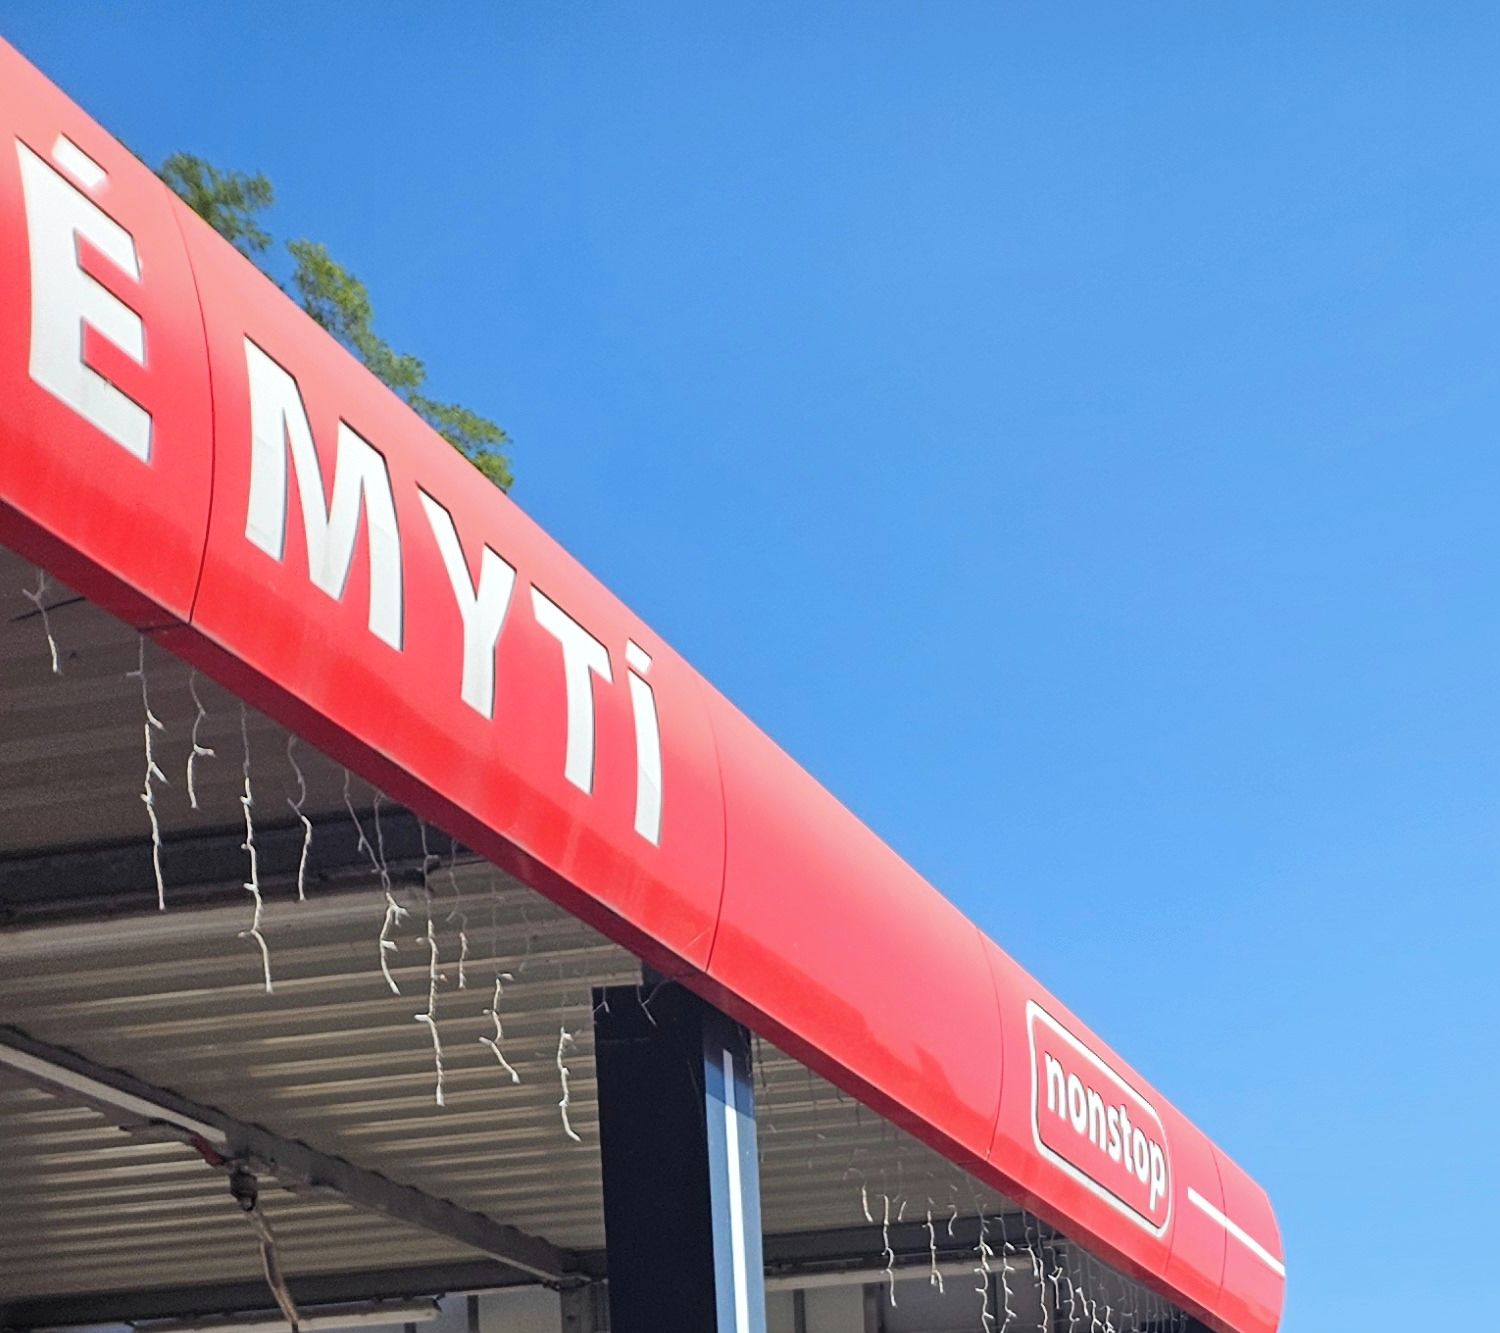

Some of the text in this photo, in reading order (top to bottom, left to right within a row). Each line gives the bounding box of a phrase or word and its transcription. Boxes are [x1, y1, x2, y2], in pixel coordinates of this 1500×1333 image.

[15, 132, 664, 848] É MYTÍ
[1044, 1051, 1166, 1211] nonstop
